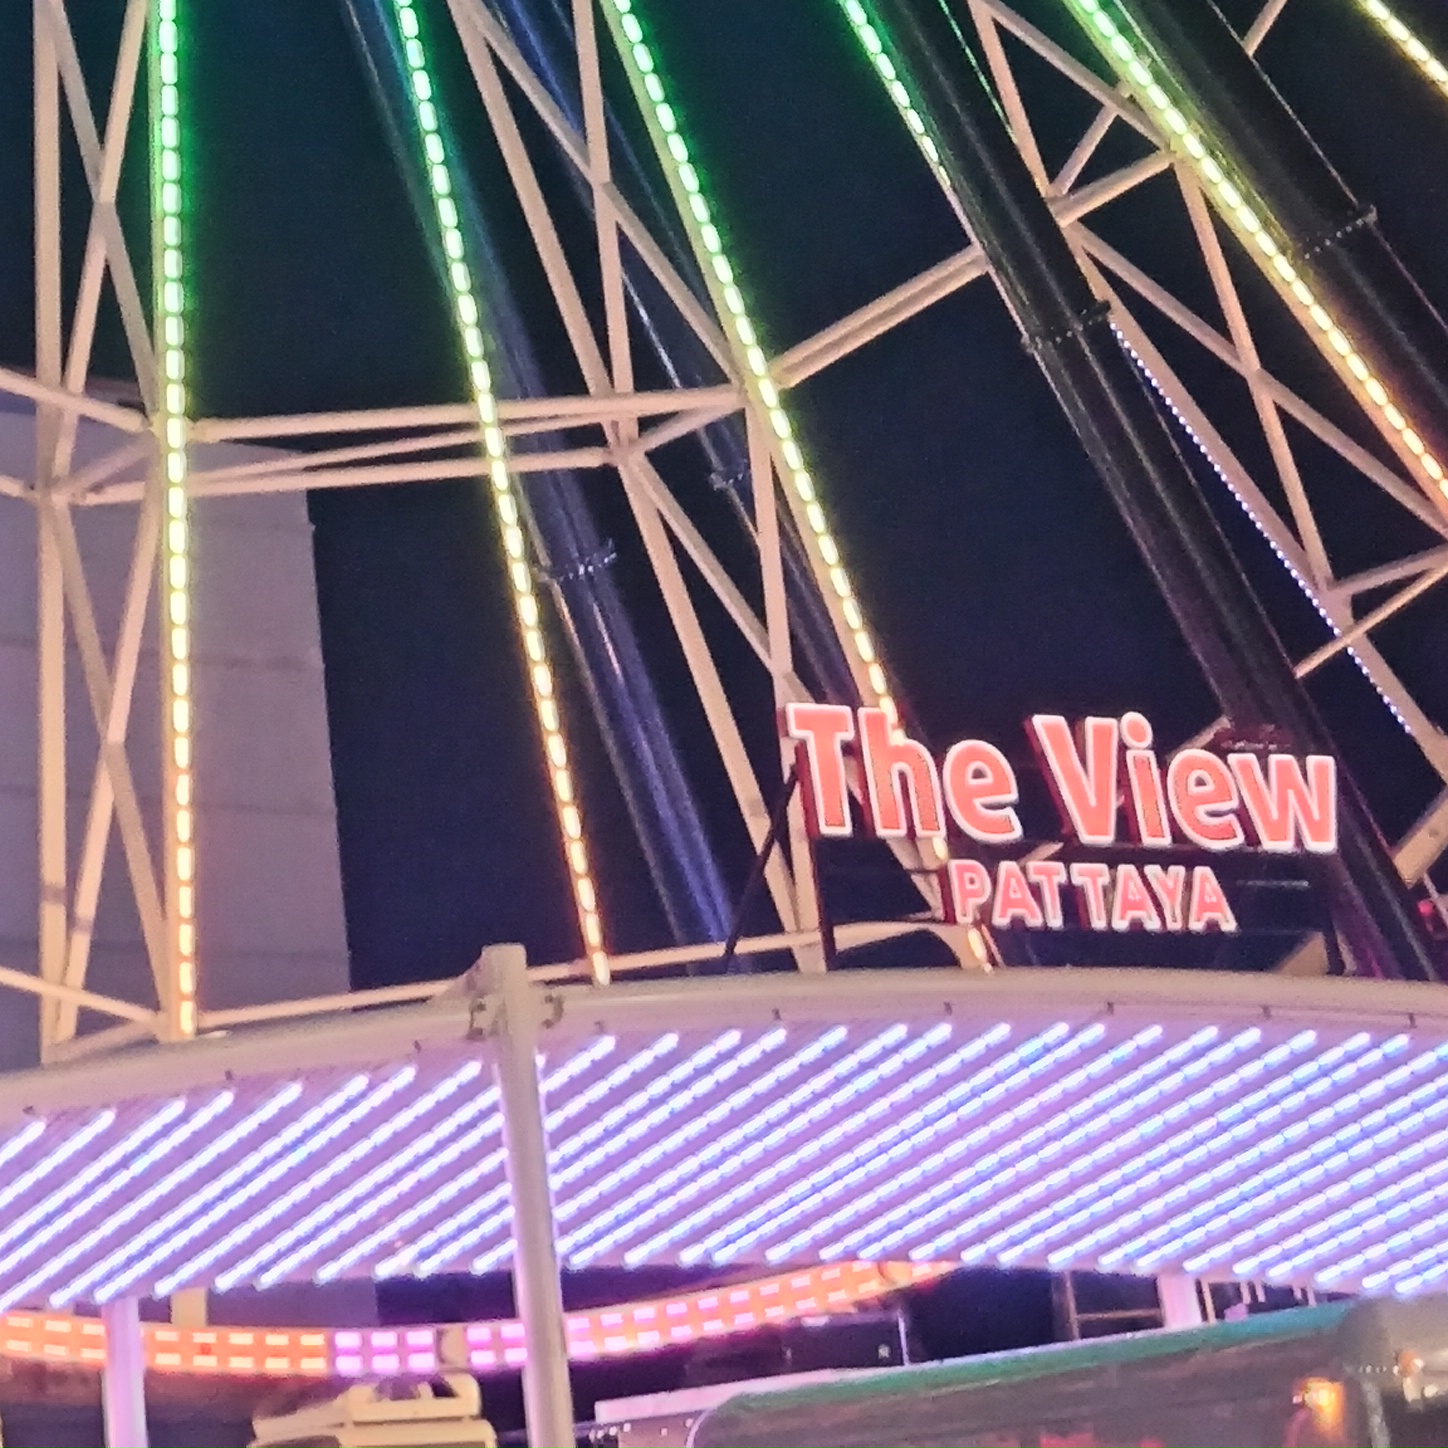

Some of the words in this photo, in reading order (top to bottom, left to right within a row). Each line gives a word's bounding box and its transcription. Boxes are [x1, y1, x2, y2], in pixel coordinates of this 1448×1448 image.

[785, 701, 1022, 844] The
[1030, 710, 1338, 853] View
[947, 858, 1237, 933] PATTAYA
